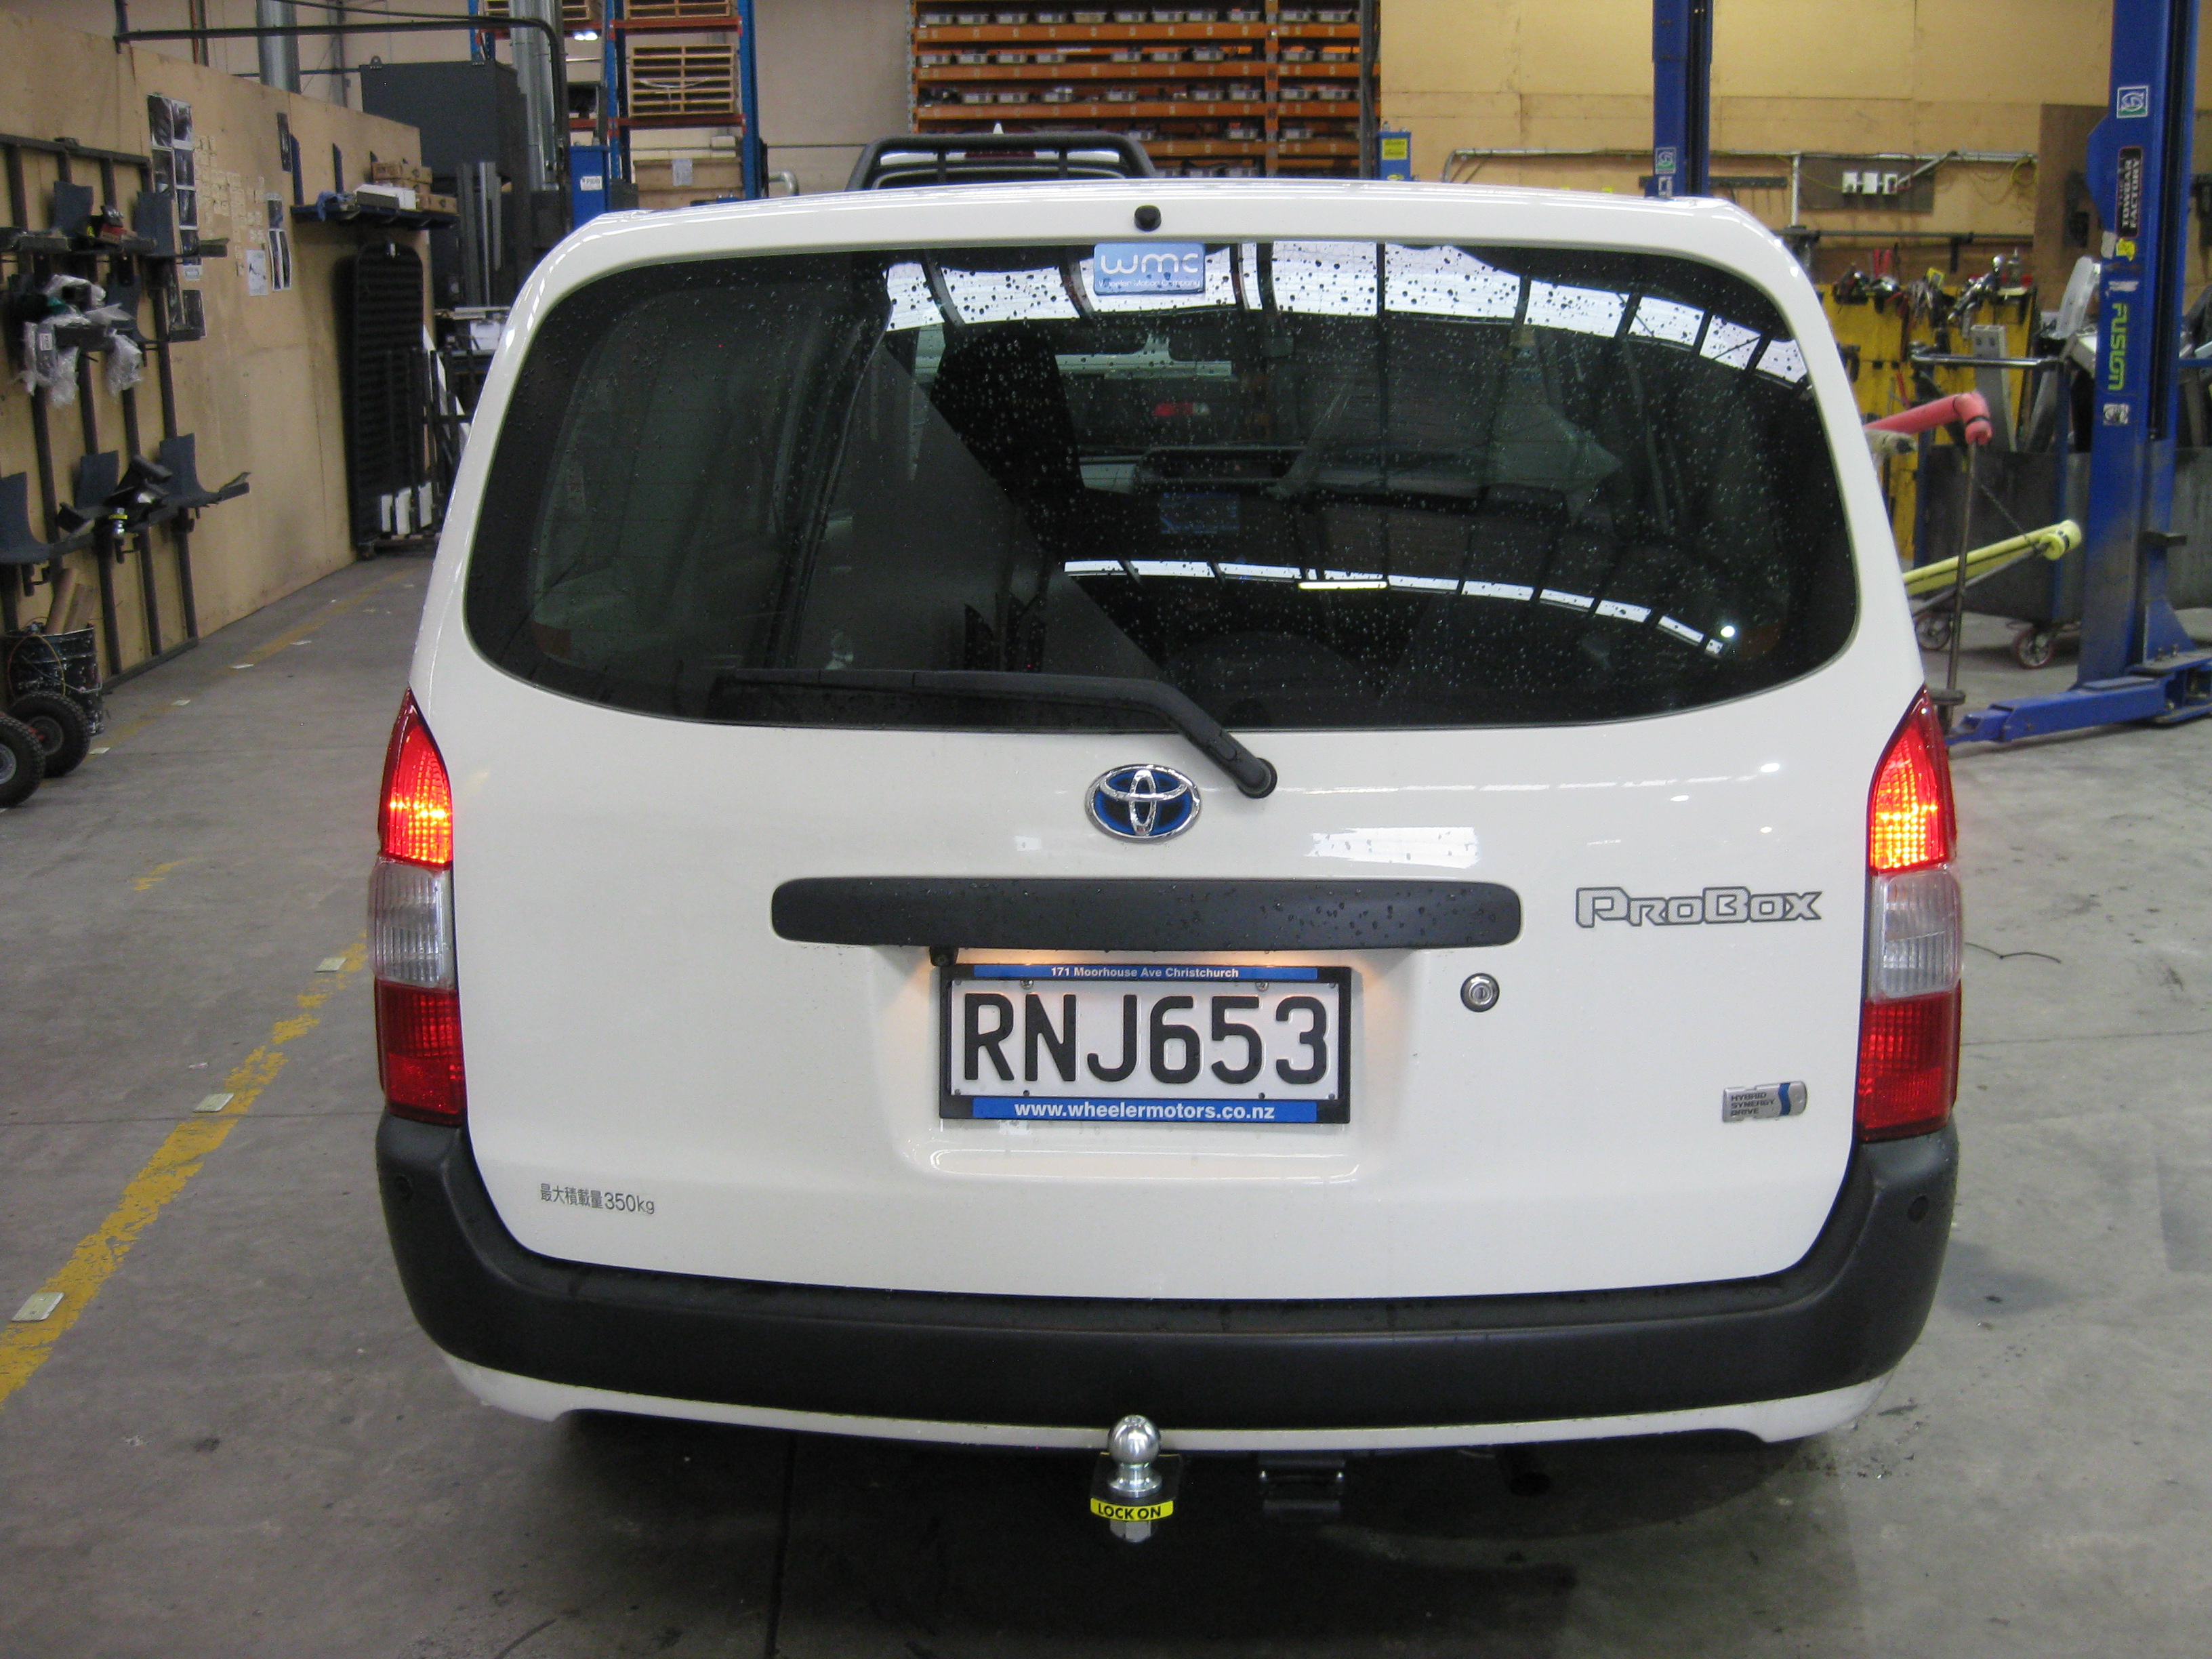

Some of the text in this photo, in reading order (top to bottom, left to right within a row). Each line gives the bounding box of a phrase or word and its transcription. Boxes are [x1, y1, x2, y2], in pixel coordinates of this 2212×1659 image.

[1051, 967, 1239, 978] 171 Moorhouse Ave Christchurch
[964, 993, 1328, 1084] RNJ653
[1015, 1102, 1275, 1120] www.wheelermotors.co.nz
[1098, 1502, 1161, 1519] LOCK ON
